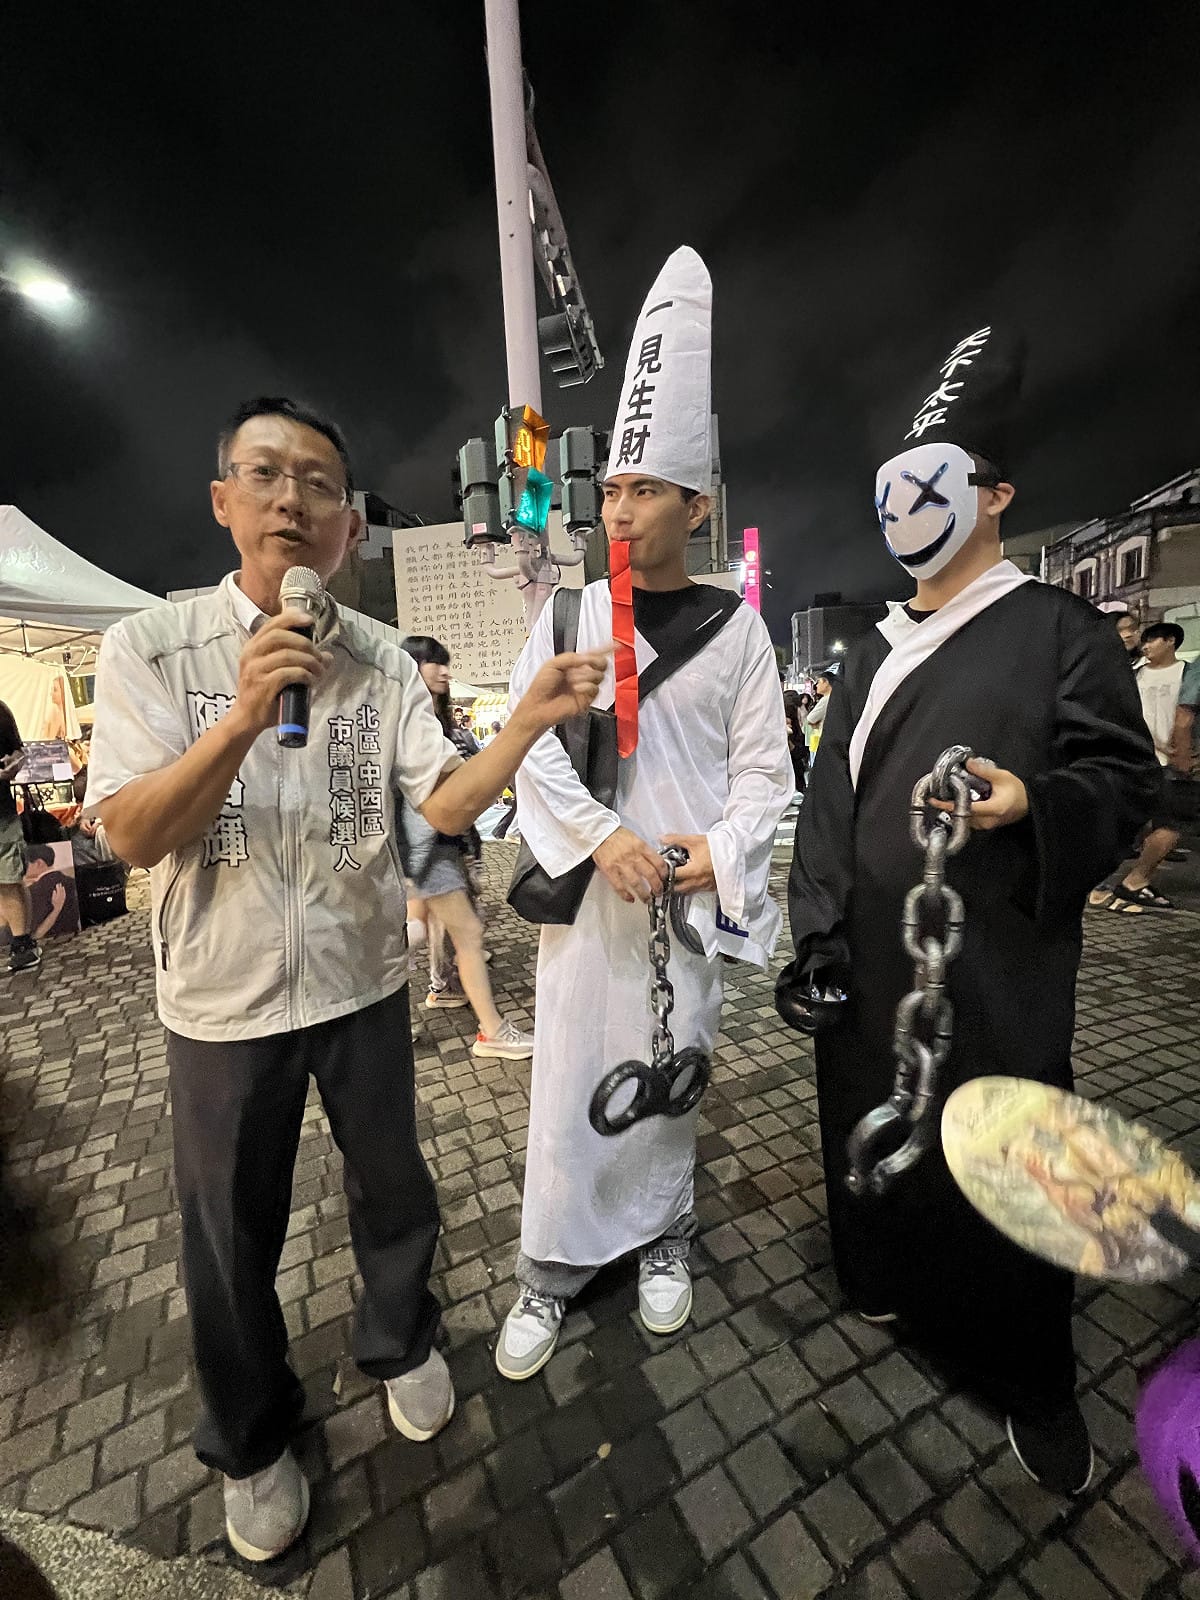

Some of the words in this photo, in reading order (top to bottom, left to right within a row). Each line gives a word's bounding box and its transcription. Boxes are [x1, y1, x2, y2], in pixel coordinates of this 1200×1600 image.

[616, 300, 674, 468] 一見生財
[904, 326, 991, 441] 天下太平
[187, 691, 249, 868] 陳輝
[328, 715, 361, 872] 市議員候選人
[356, 703, 380, 755] 北區
[358, 761, 384, 838] 中西區
